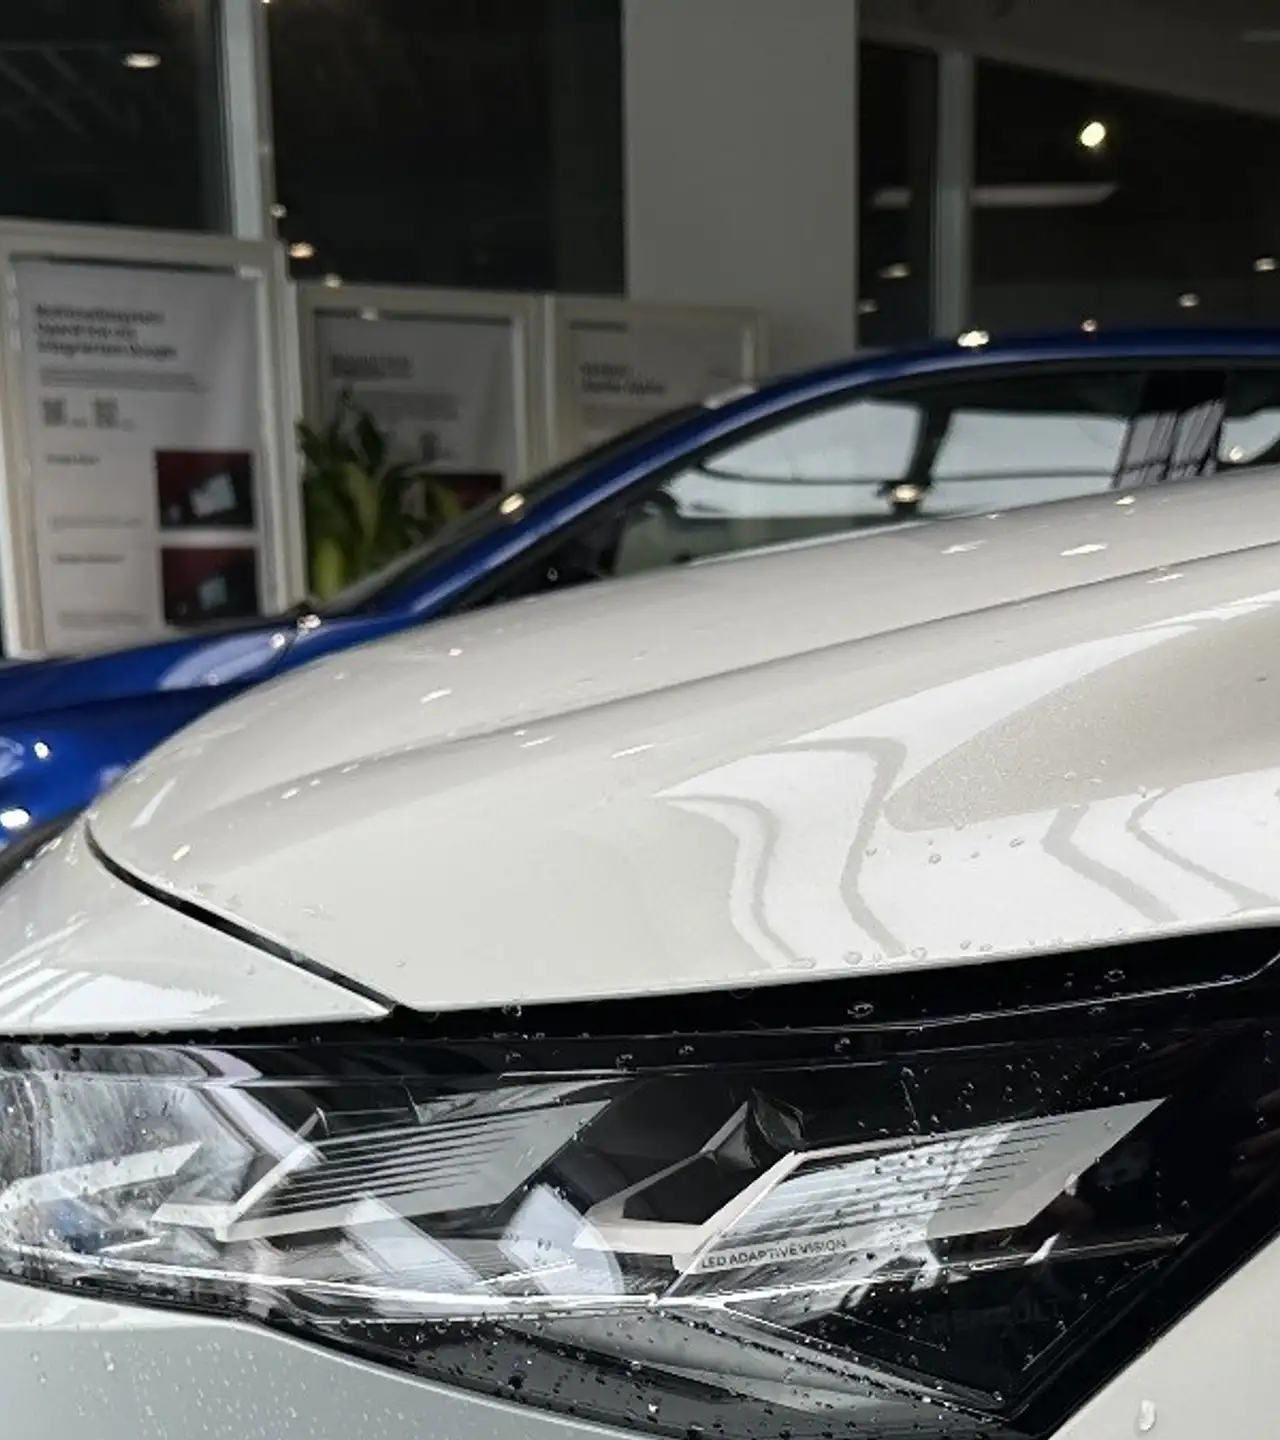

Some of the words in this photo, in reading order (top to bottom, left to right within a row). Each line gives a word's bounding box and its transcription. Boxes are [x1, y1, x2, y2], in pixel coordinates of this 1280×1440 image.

[701, 1255, 727, 1269] LED
[729, 1244, 798, 1266] ADAPTIVE
[799, 1236, 848, 1254] VISION
